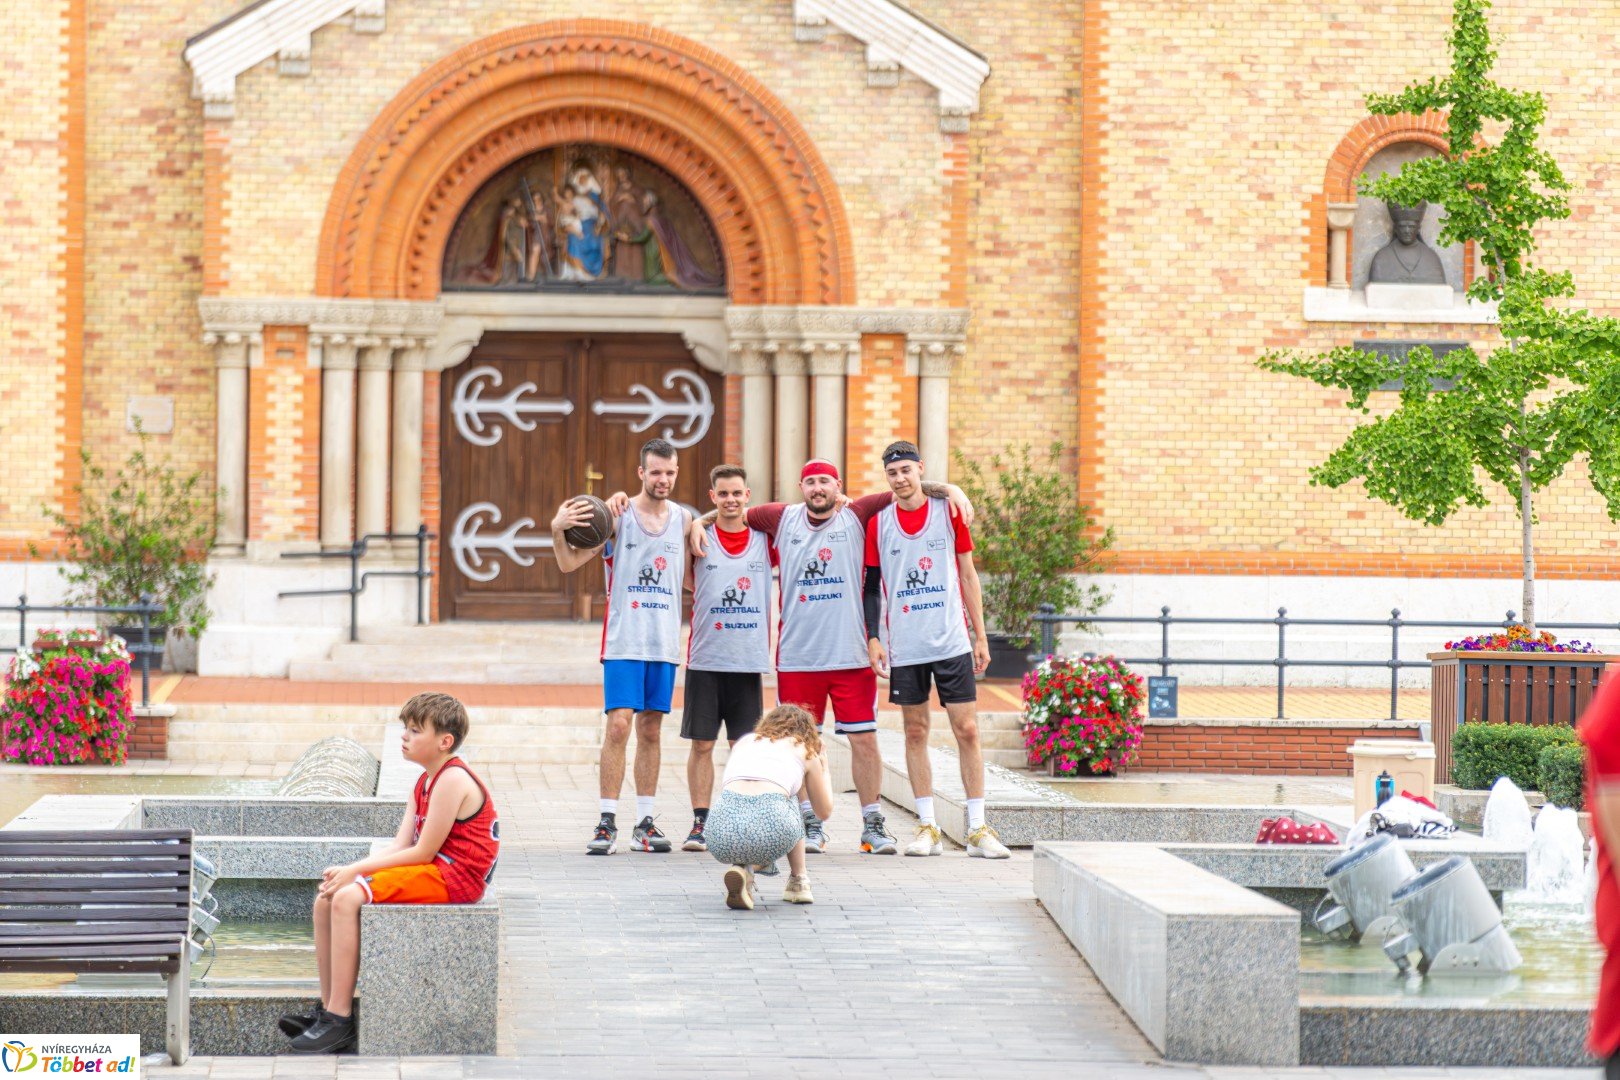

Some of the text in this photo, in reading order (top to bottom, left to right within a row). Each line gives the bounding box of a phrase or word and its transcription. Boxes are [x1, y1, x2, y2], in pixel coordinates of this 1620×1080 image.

[808, 592, 842, 601] SUZUKI
[641, 602, 669, 610] SUZUKI
[911, 601, 945, 611] SUZUKI
